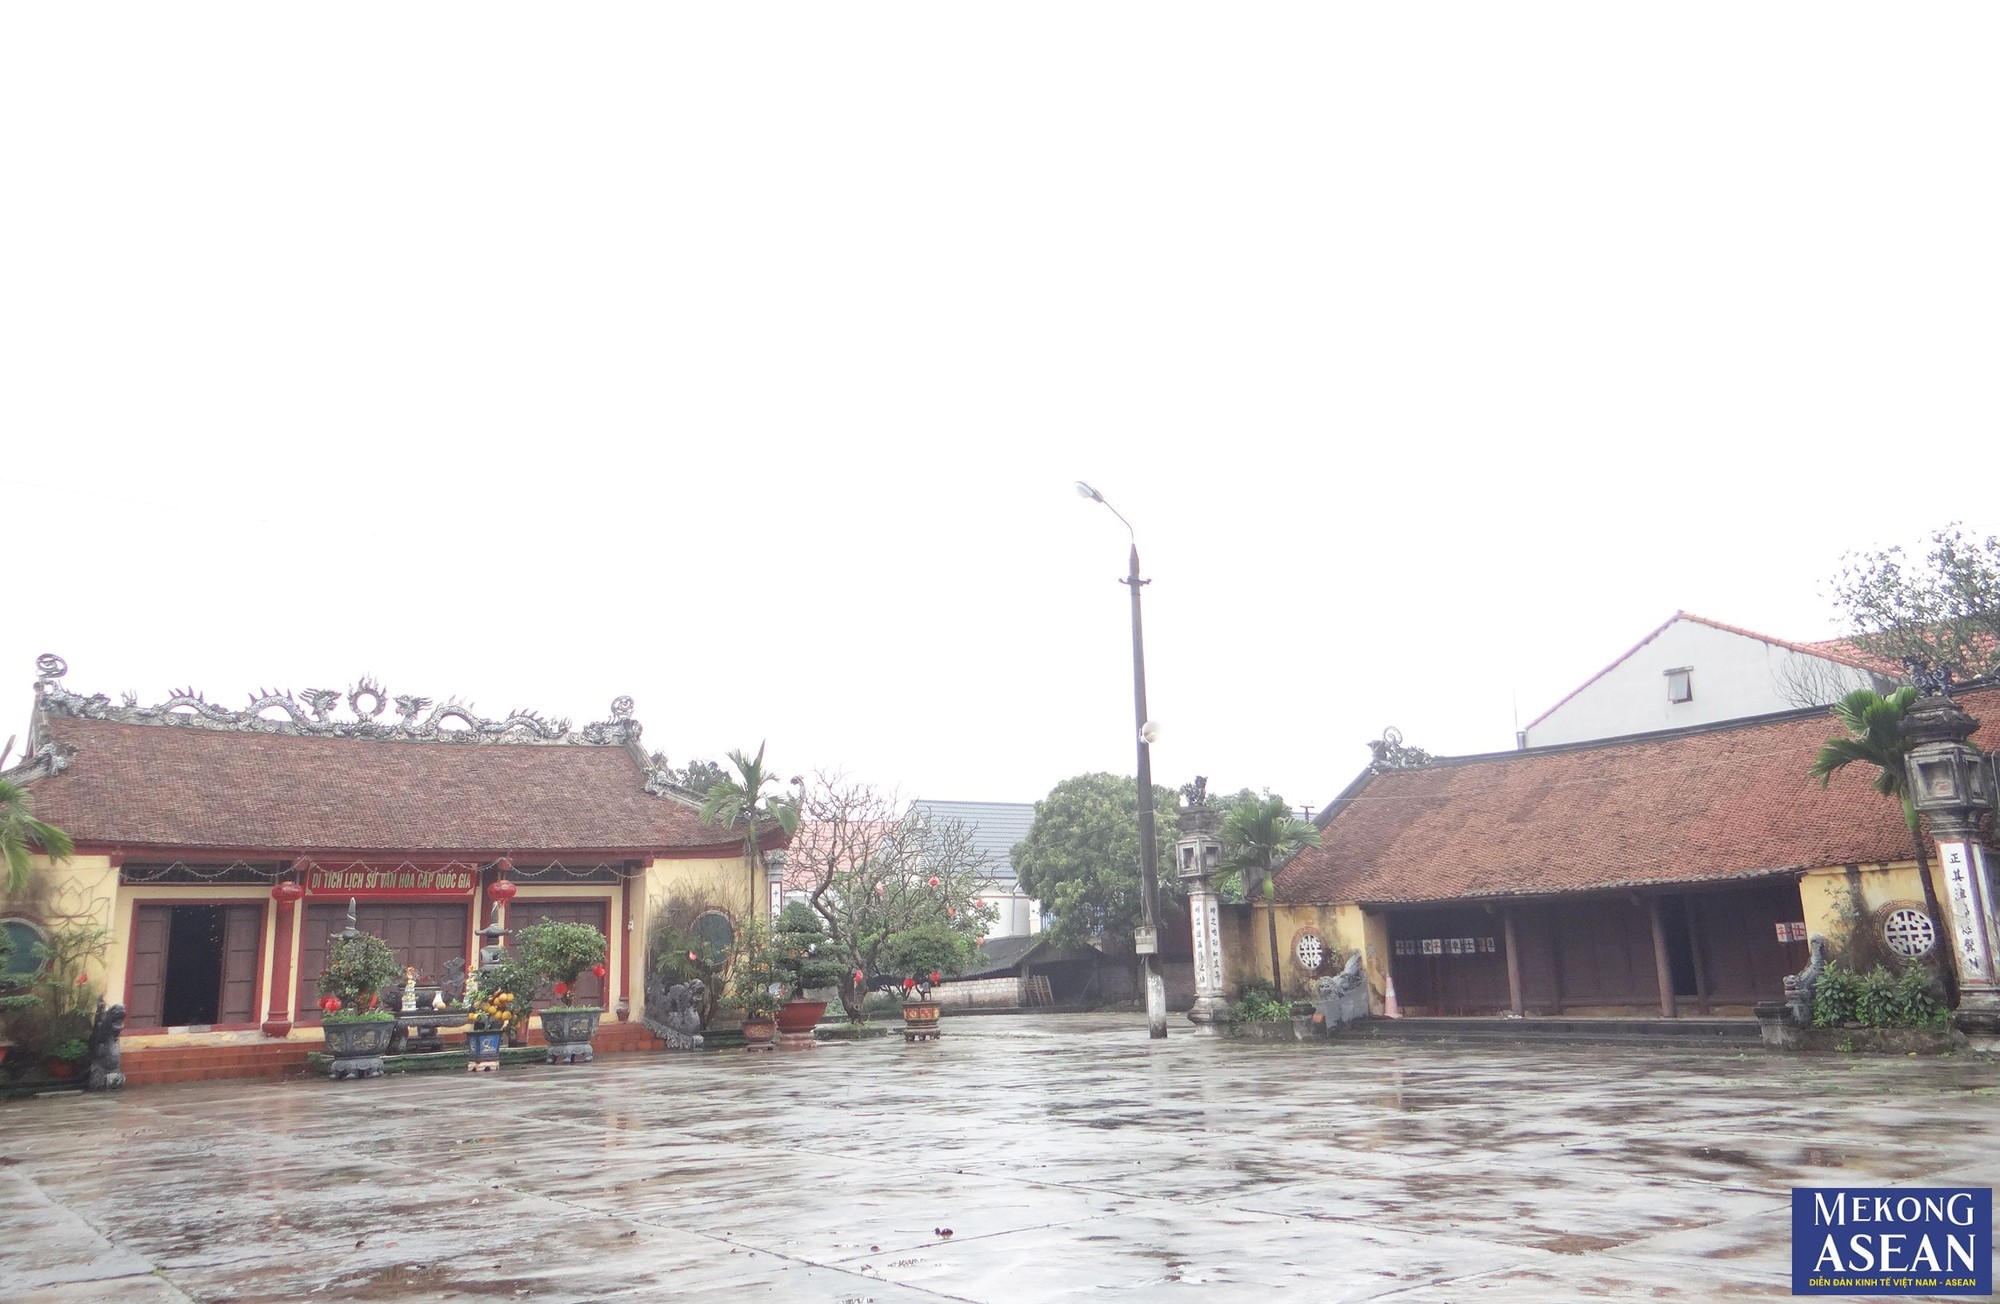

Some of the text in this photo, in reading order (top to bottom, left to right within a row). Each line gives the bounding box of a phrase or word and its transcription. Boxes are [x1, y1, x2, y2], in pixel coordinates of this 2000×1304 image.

[311, 872, 321, 888] DI
[344, 872, 363, 891] LỊCH
[435, 869, 456, 890] QUỐC
[458, 872, 471, 888] GIA
